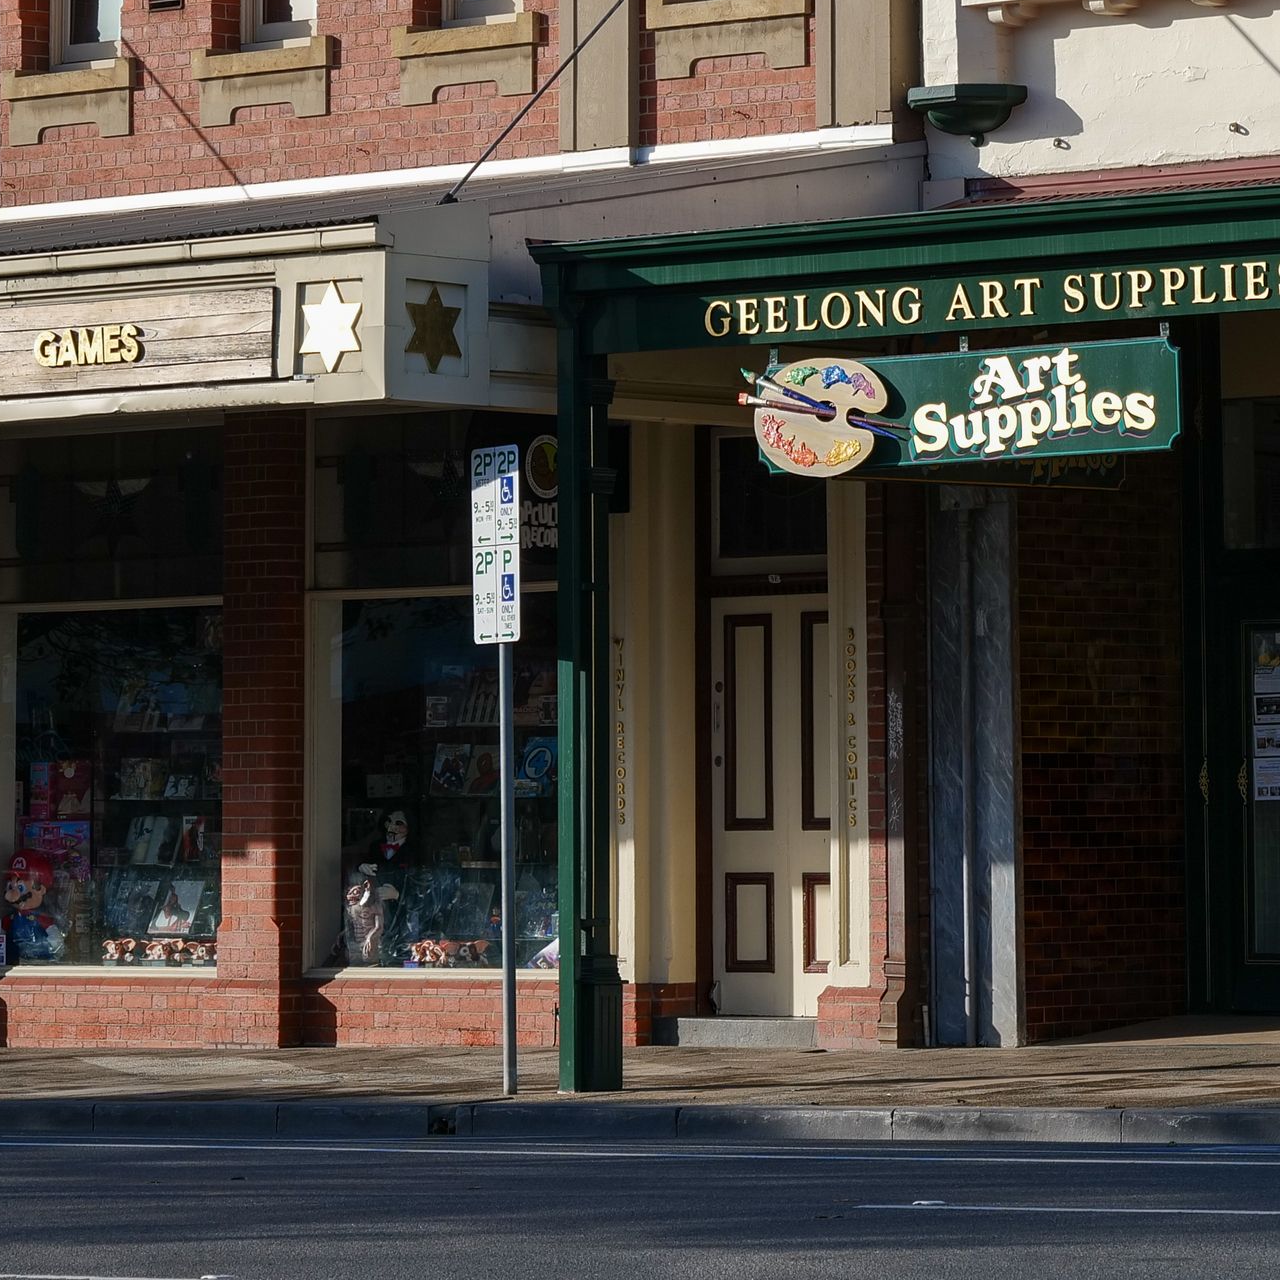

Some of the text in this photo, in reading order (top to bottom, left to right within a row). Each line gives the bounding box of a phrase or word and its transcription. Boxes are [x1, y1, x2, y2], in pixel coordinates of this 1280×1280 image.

[704, 286, 924, 338] GEELONG
[945, 277, 1042, 322] ART
[34, 324, 145, 368] GAMES
[969, 347, 1081, 407] Art
[909, 382, 1157, 460] Supplies
[474, 453, 492, 476] 2P
[497, 450, 516, 474] 2P
[500, 507, 513, 516] ONLY
[475, 551, 494, 575] 2P
[503, 549, 512, 572] P
[502, 605, 514, 614] ONLY
[614, 637, 626, 825] VINYL RECORDS
[845, 627, 858, 827] BOOKS & COMICS
